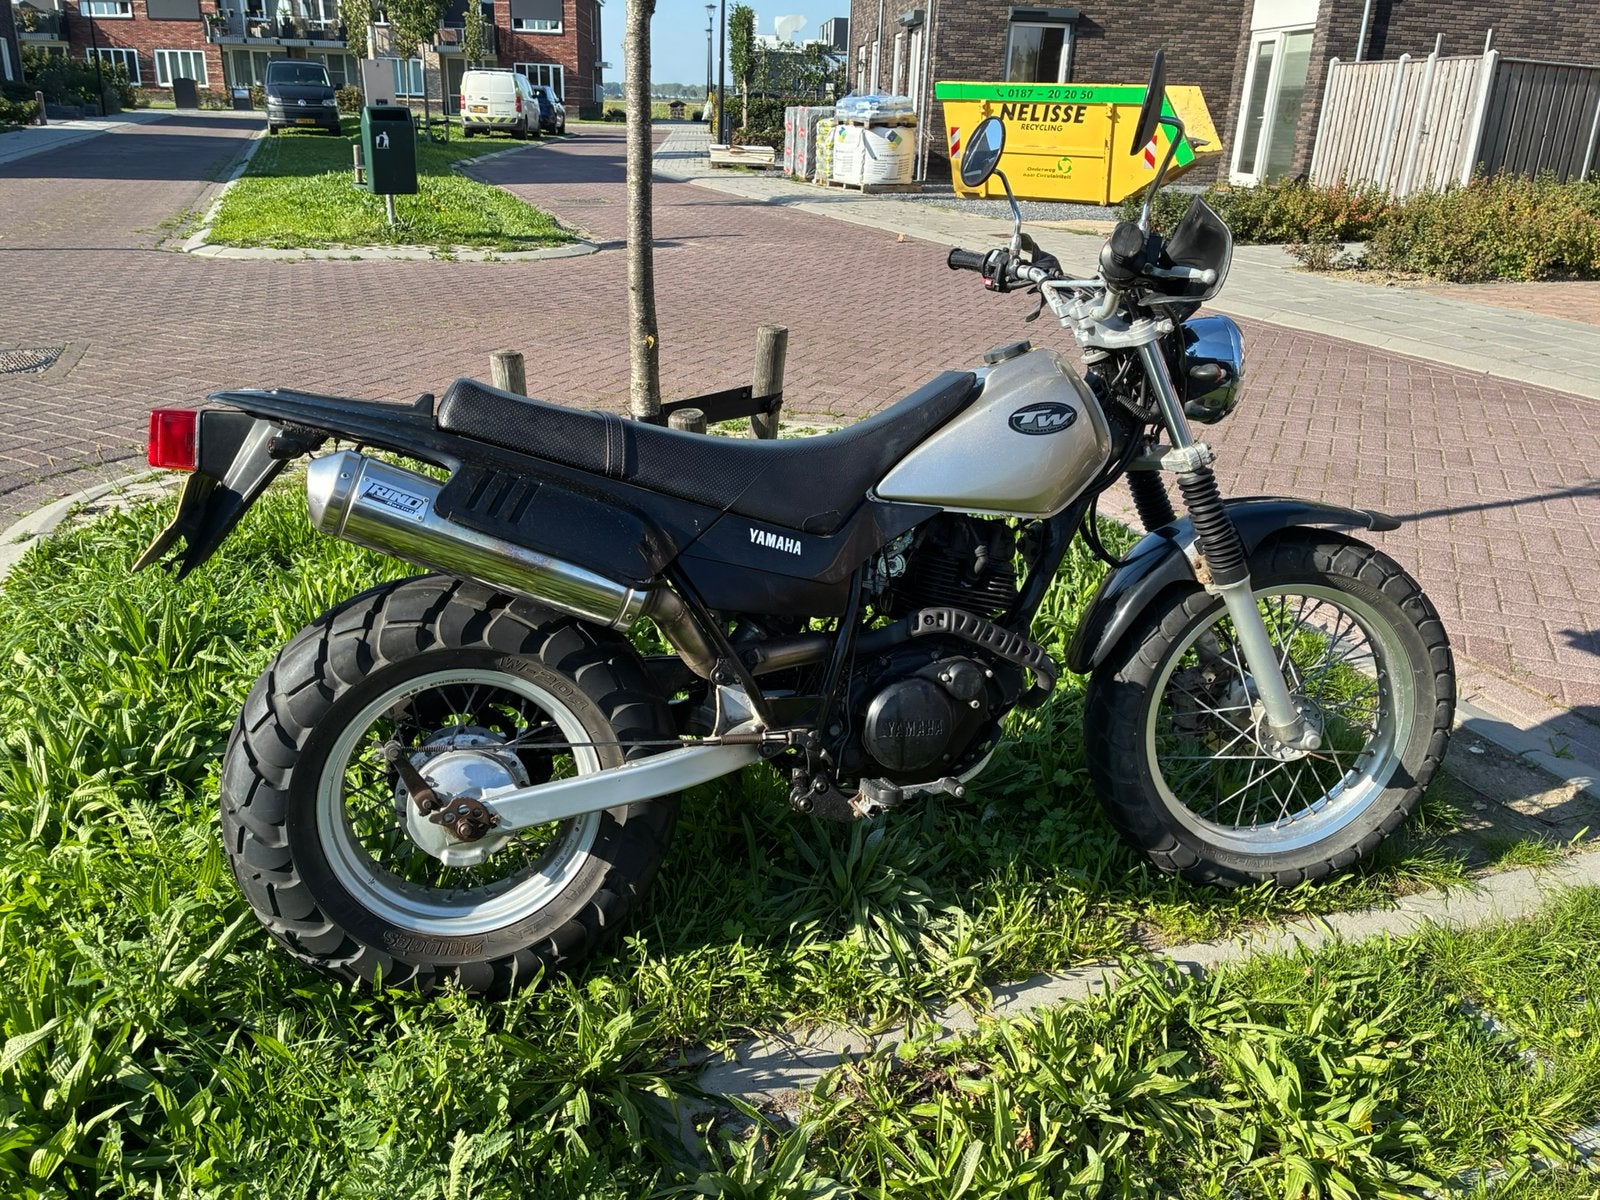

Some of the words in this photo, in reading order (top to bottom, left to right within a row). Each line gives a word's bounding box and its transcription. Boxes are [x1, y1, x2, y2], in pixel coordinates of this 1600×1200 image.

[1007, 89, 1033, 99] 0187
[1047, 90, 1061, 99] 20
[1063, 90, 1077, 99] 20
[1079, 90, 1094, 100] 50
[1000, 103, 1087, 123] NELISSE
[1020, 123, 1063, 132] RECYCLING
[1011, 409, 1074, 428] TW
[369, 483, 424, 511] RINO
[749, 527, 802, 556] YAMAHA
[887, 719, 944, 738] YAMAHA
